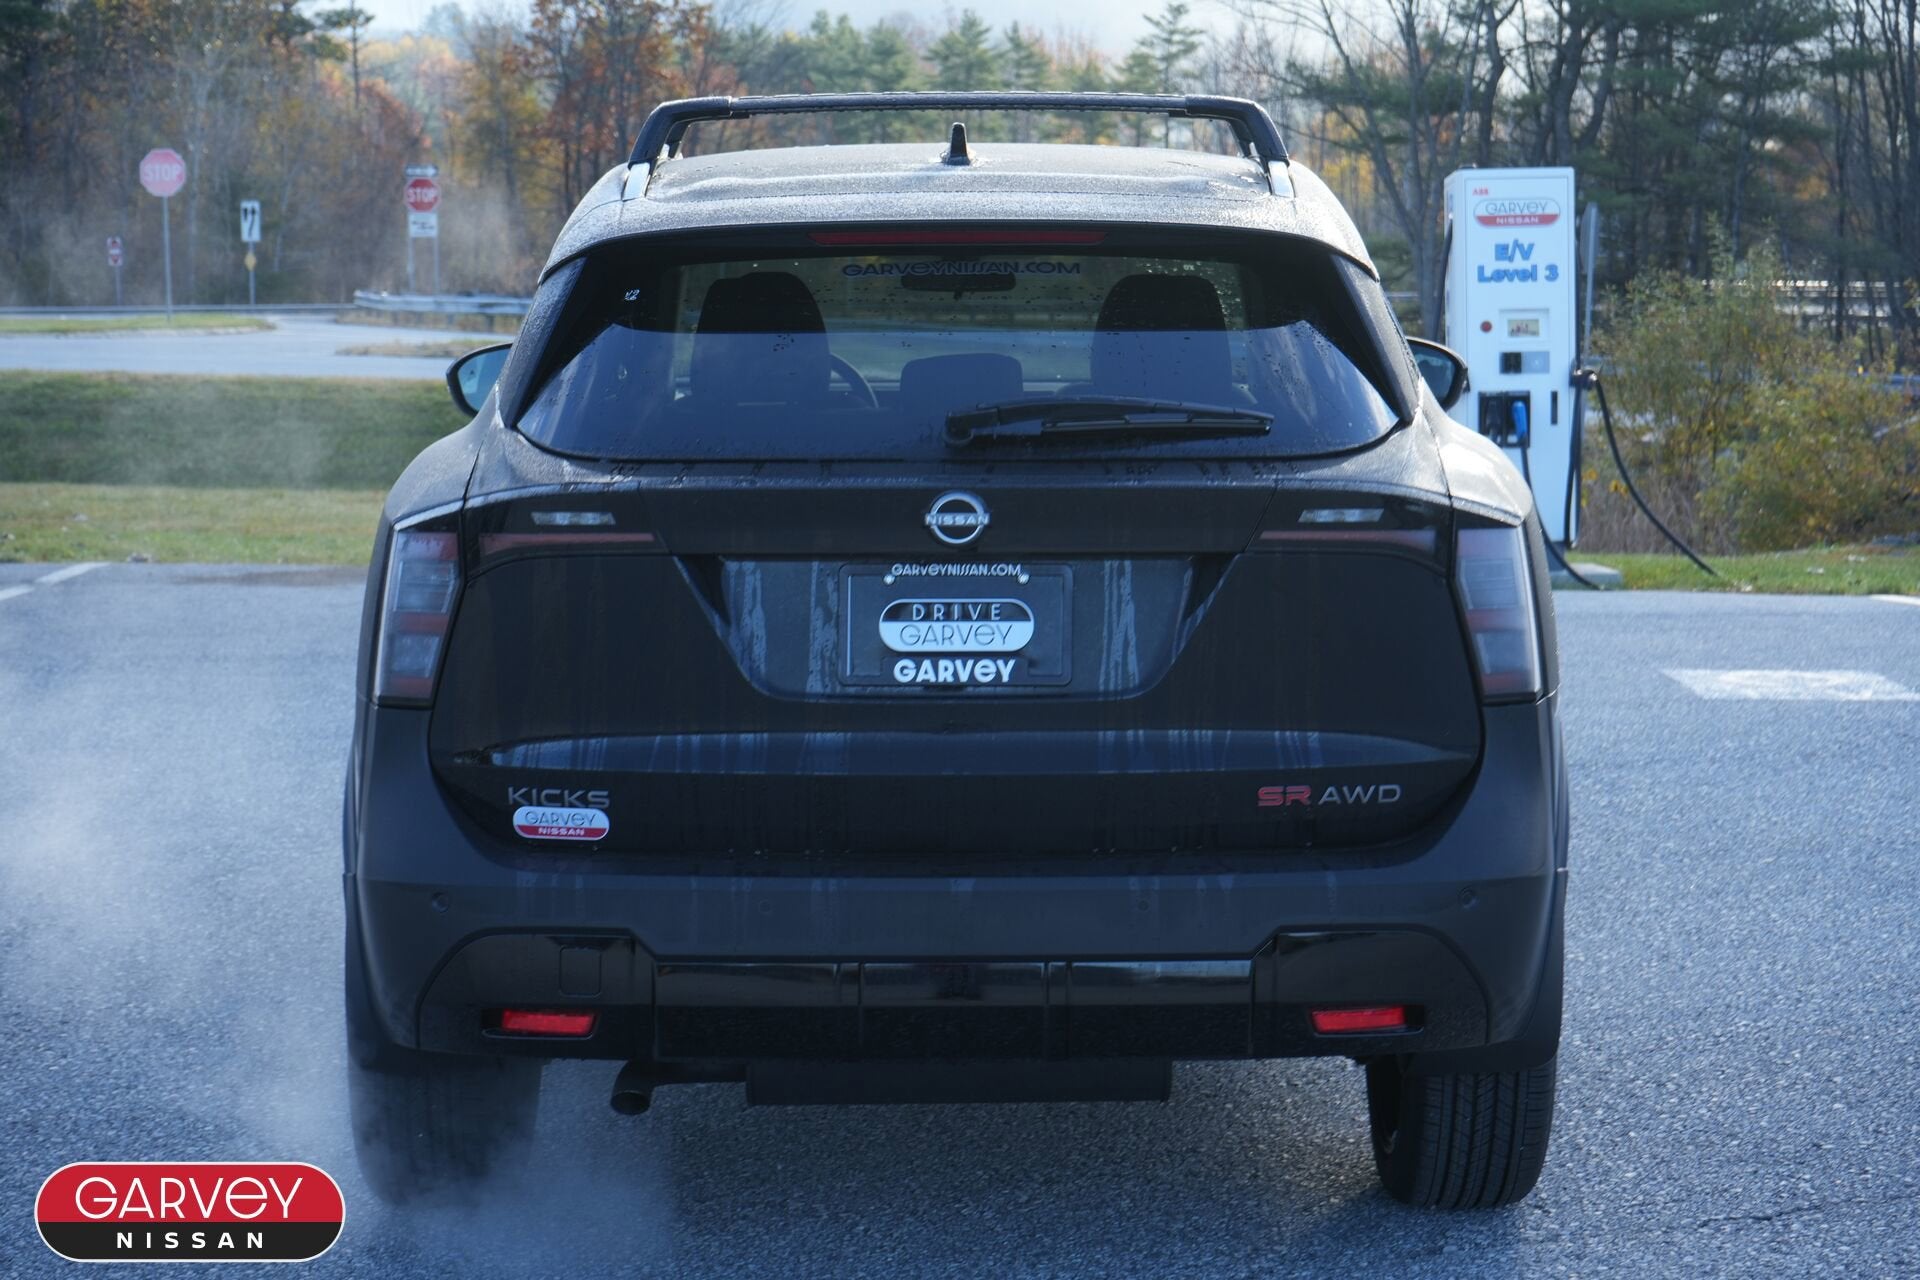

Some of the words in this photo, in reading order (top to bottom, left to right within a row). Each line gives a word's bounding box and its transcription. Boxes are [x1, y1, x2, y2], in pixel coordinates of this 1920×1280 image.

[144, 163, 182, 181] STOP
[407, 188, 438, 203] STOP
[1485, 201, 1548, 215] GARVEY
[1496, 216, 1539, 225] NISSAN
[1494, 238, 1535, 263] E/V
[842, 261, 1081, 277] GARVEYNISSAN.COM
[1477, 264, 1538, 283] Level
[1544, 264, 1559, 283] 3
[925, 513, 990, 525] NISSAN
[891, 563, 1021, 576] GARVEYNISSAN.COM
[912, 604, 1001, 621] DRIVE
[900, 624, 1013, 646] GARVEY
[893, 659, 1016, 683] GARVEY
[507, 786, 610, 808] KICKS
[1257, 785, 1311, 807] SR
[1318, 784, 1402, 805] AWD
[525, 811, 597, 827] GARVEY
[538, 827, 585, 836] NISSAN
